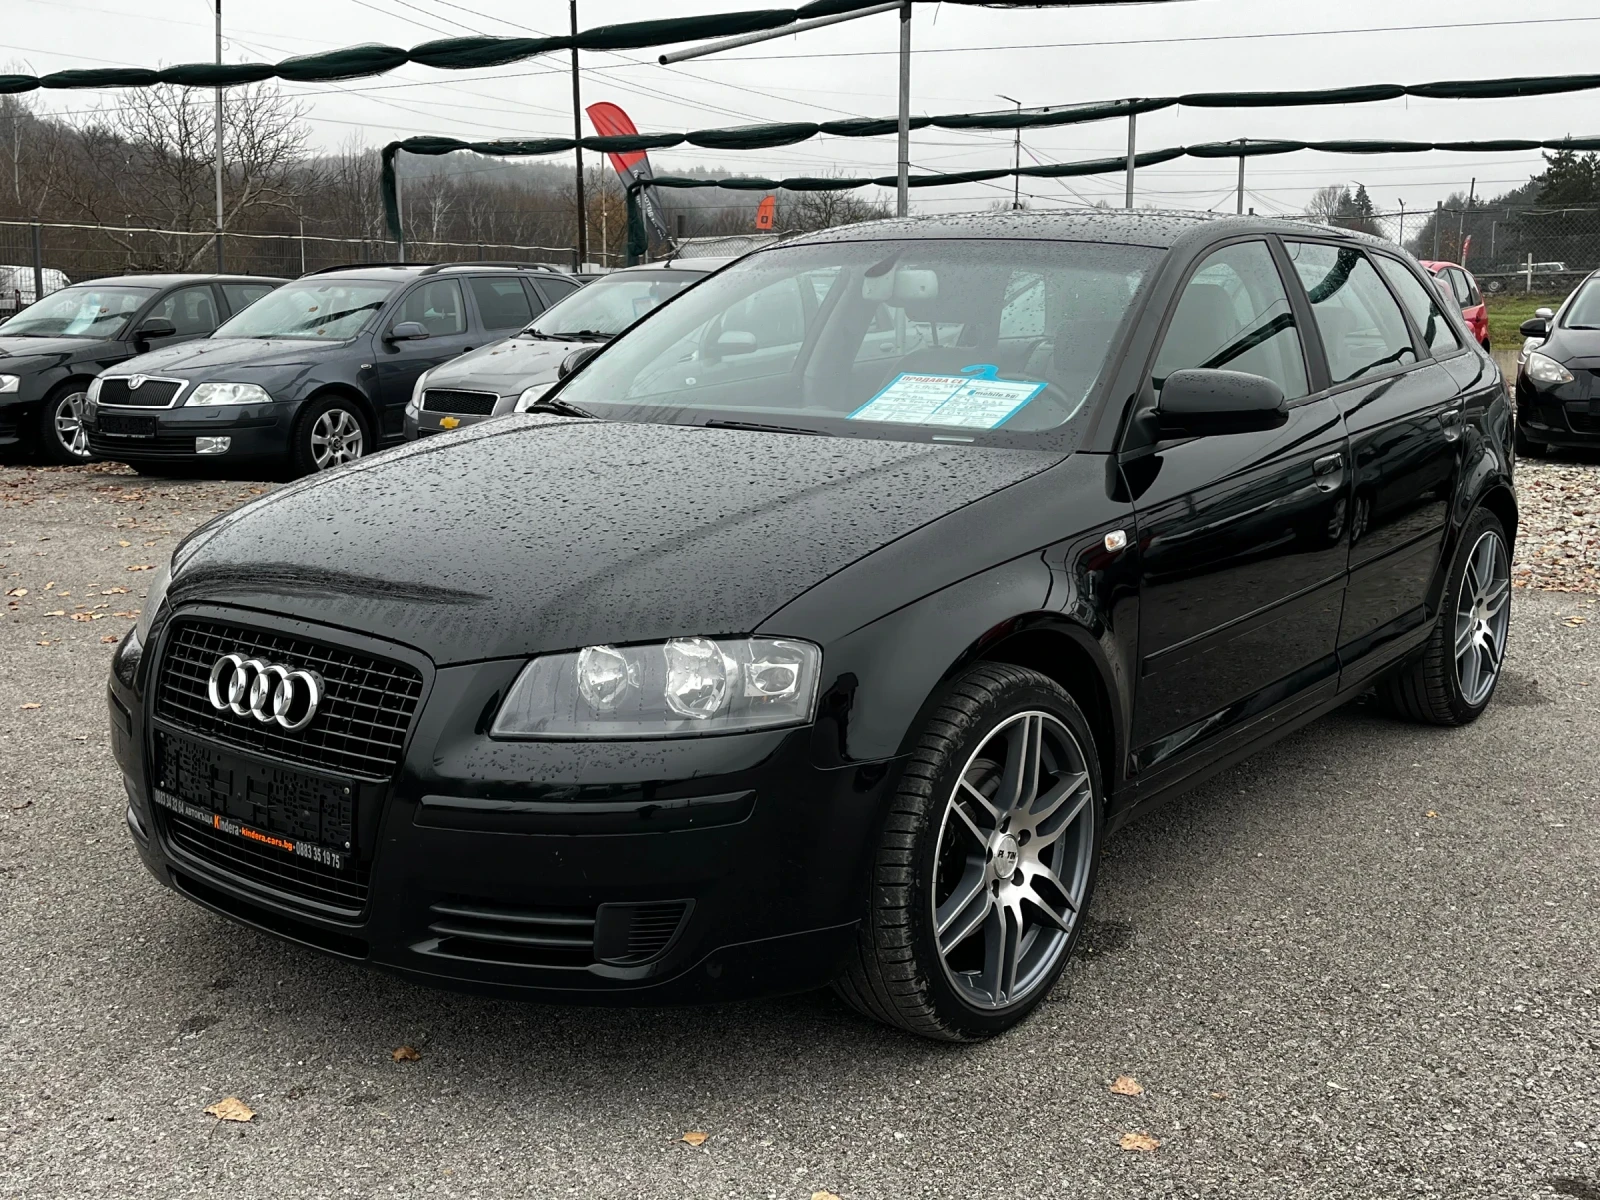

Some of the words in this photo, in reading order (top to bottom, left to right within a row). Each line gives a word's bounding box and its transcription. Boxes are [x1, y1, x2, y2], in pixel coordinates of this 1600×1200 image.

[902, 376, 949, 384] ПРОДАВА
[184, 807, 213, 825] АВТОКЪЩА
[214, 815, 239, 835] Kindera
[241, 828, 293, 851] kindera.cars.bg
[295, 842, 312, 859] 0883
[313, 847, 321, 862] 35
[322, 850, 331, 865] 19
[331, 853, 340, 869] 75
